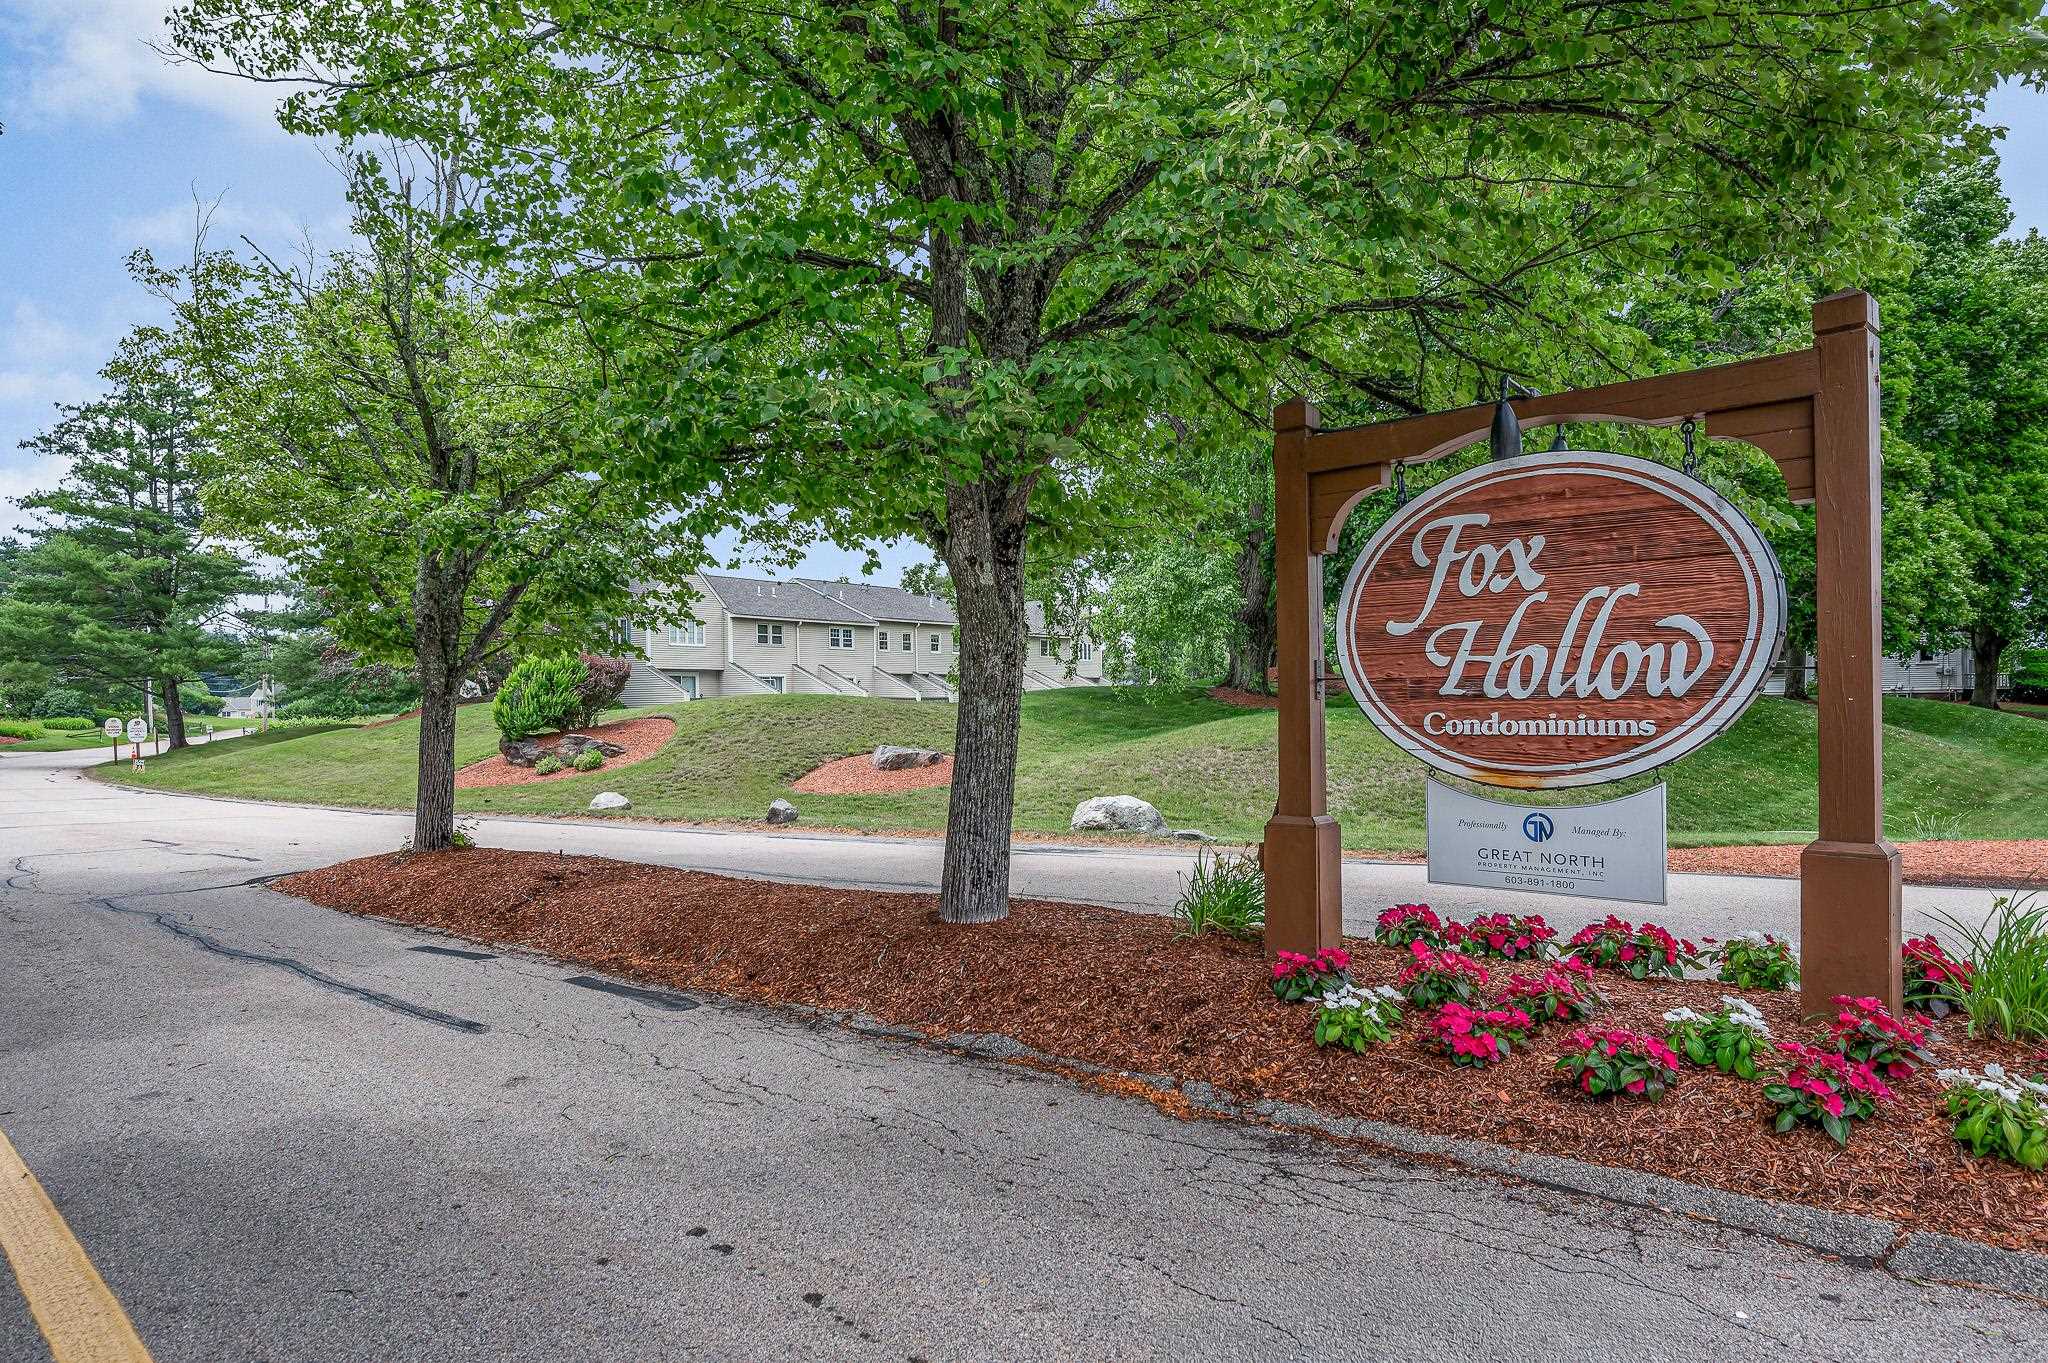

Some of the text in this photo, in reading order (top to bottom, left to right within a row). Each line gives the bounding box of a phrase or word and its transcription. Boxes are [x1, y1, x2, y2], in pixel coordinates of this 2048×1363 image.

[1385, 513, 1547, 636] Fox
[1424, 582, 1715, 700] Hollow
[1423, 712, 1657, 737] Condominiums
[1457, 818, 1507, 832] Professionally
[1571, 826, 1627, 840] Managed By:
[1477, 847, 1605, 869] GREAT NORTH
[1477, 861, 1518, 871] PROPERTY
[1521, 865, 1585, 876] MANAGEMENT,
[1504, 876, 1575, 890] 603-891-1800
